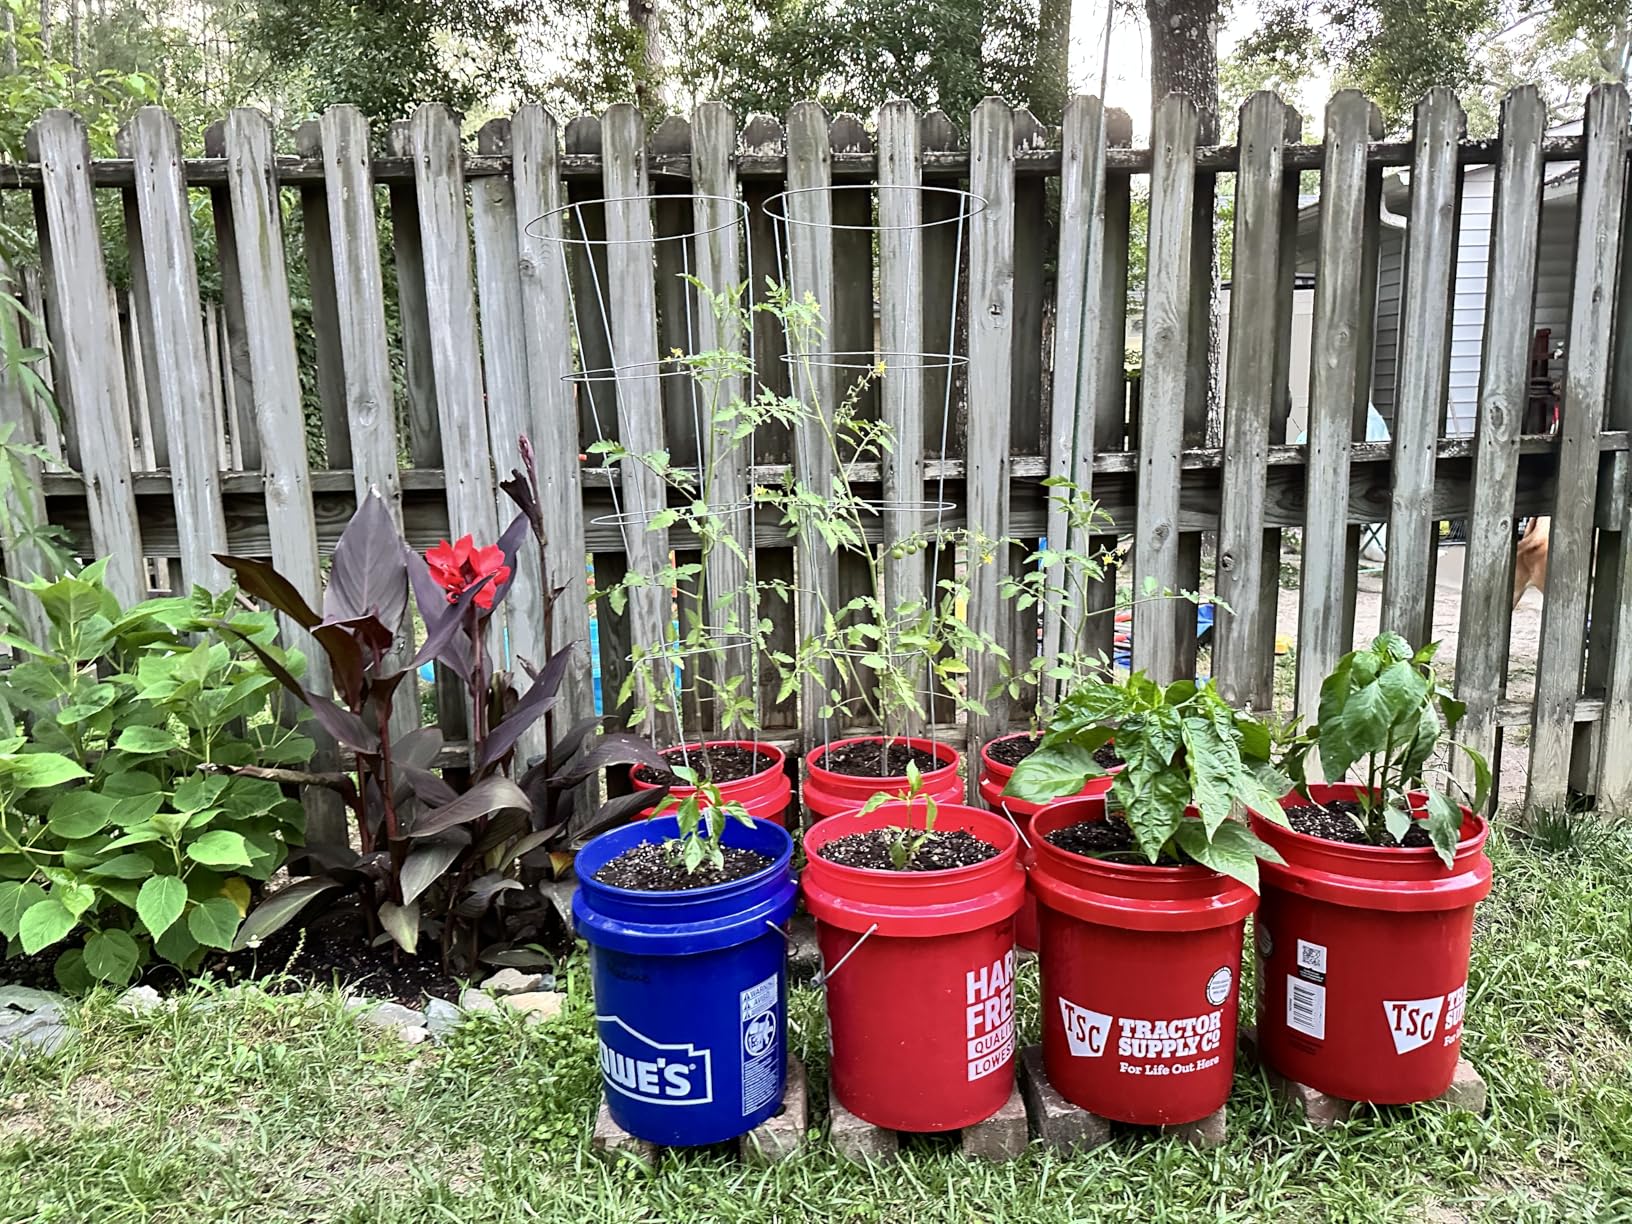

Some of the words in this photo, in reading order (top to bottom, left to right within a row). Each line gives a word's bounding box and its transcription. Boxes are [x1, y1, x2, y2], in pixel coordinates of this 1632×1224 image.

[966, 950, 1014, 1004] HAR
[1064, 1003, 1101, 1053] TSC
[1118, 1010, 1221, 1039] TRACTOR
[1392, 1003, 1434, 1041] TSC
[1118, 1036, 1201, 1058] SUPPLY
[1120, 1062, 1142, 1075] For
[1145, 1065, 1170, 1076] Life
[1172, 1063, 1195, 1075] Out
[1196, 1056, 1220, 1071] Here
